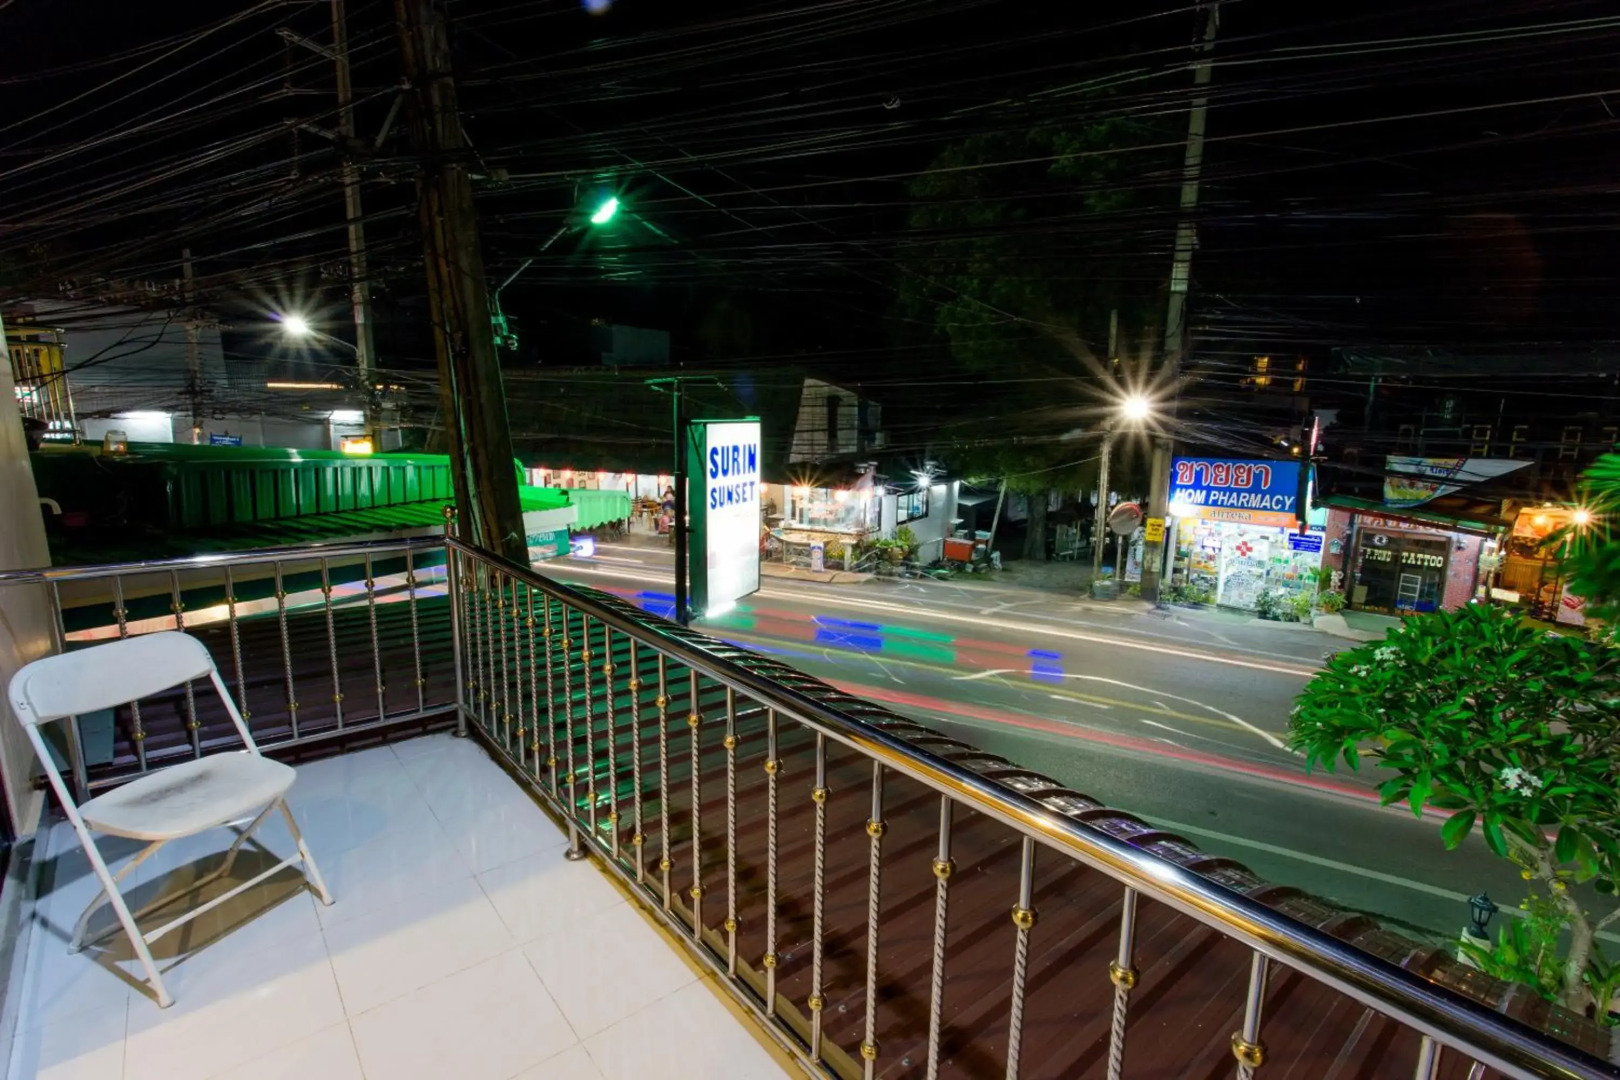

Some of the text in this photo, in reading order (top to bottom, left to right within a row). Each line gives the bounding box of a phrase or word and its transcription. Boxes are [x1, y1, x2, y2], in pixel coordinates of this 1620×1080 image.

[709, 442, 757, 479] SURIN
[1176, 461, 1272, 489] ขายยา
[710, 481, 756, 511] SUNSET
[1174, 488, 1295, 511] HOM PHARMACY
[1401, 551, 1444, 568] TATTOO
